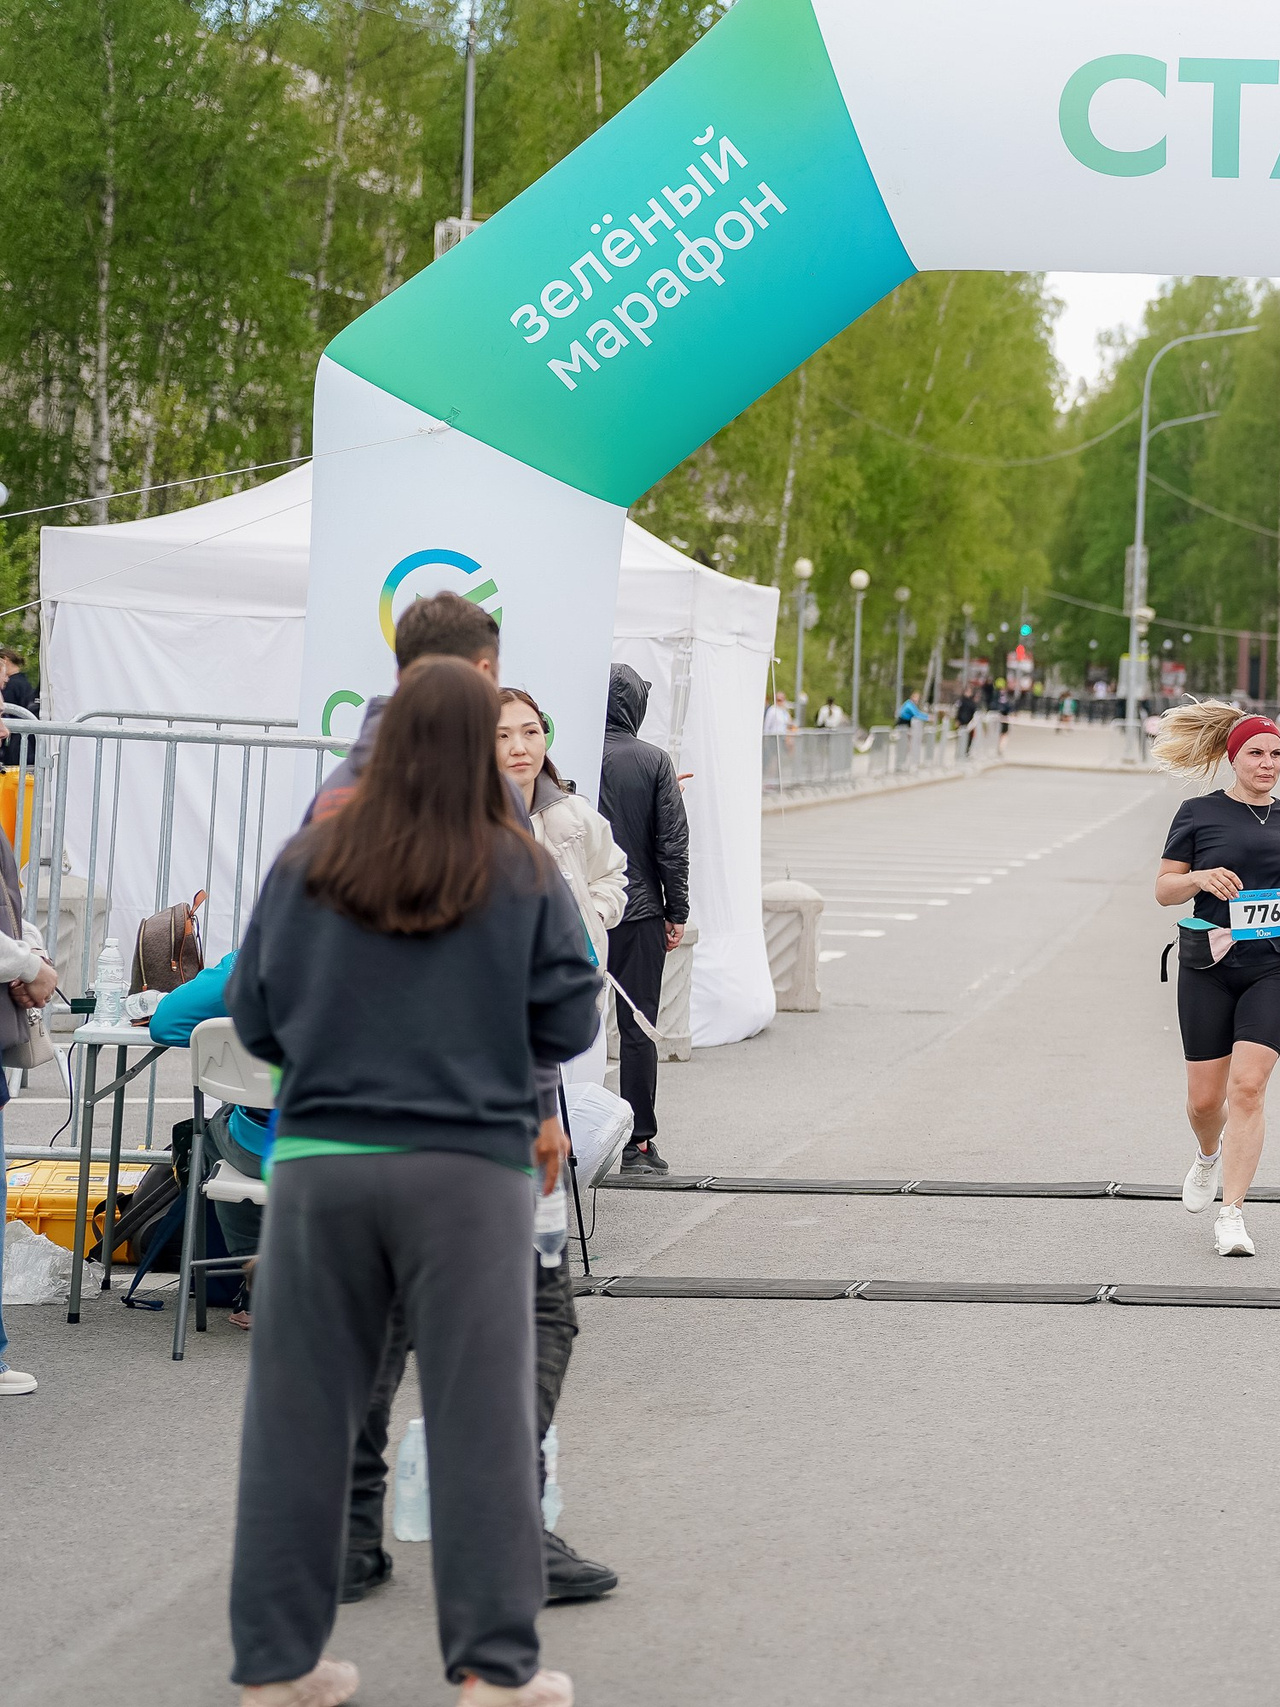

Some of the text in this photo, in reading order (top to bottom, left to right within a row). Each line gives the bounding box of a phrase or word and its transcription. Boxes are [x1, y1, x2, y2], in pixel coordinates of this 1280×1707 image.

[509, 124, 749, 344] зелёный
[546, 181, 788, 392] марафон
[1243, 903, 1280, 925] 776
